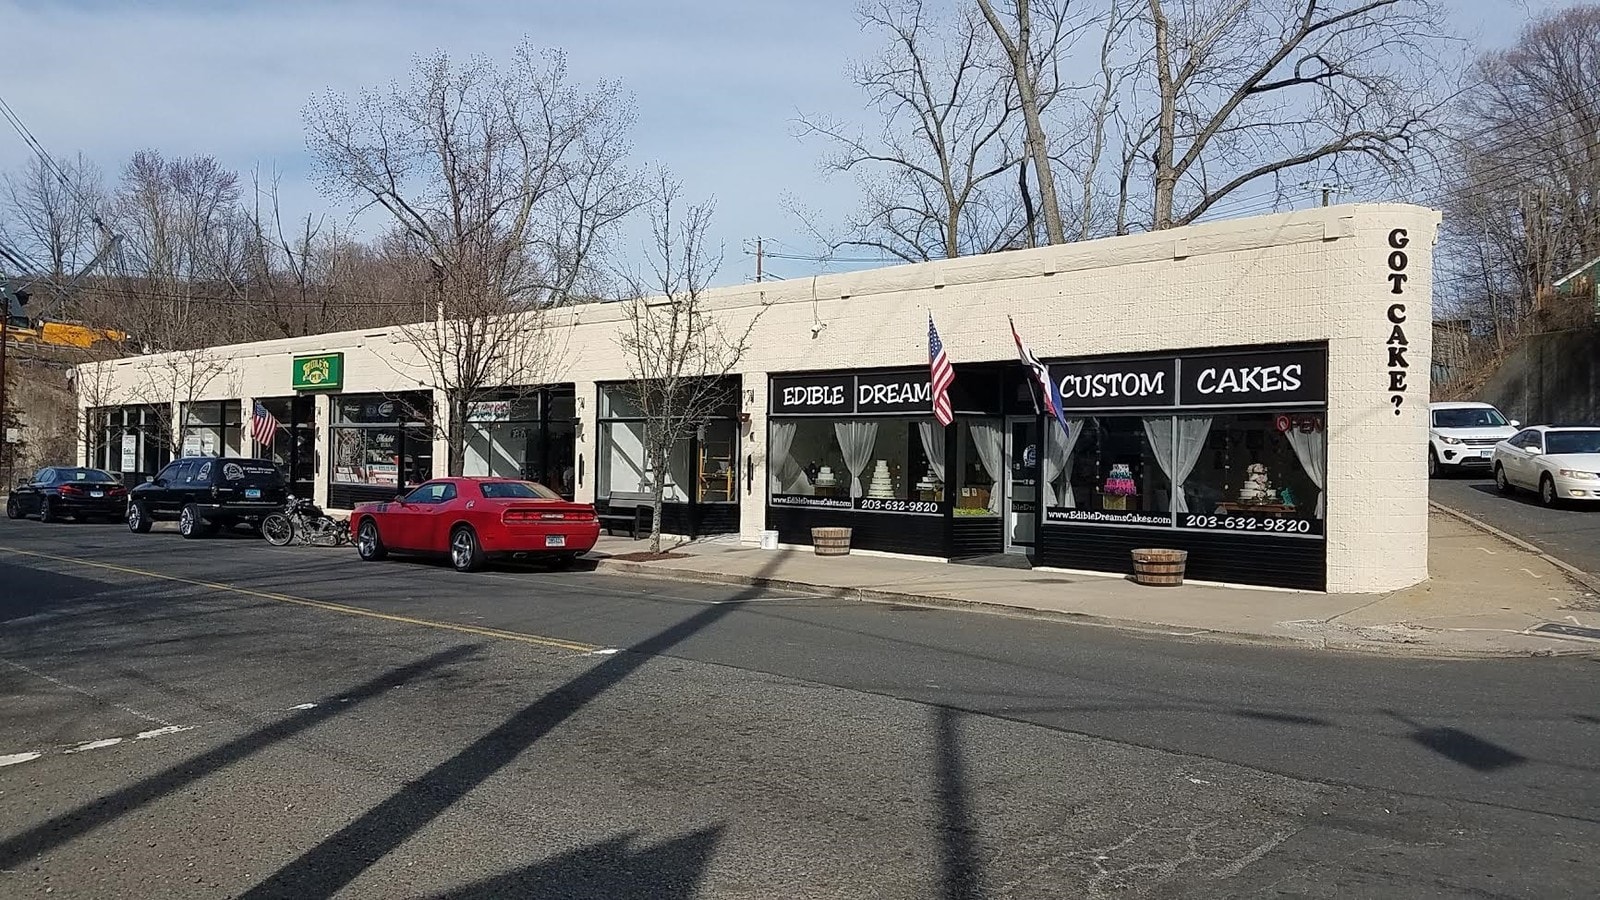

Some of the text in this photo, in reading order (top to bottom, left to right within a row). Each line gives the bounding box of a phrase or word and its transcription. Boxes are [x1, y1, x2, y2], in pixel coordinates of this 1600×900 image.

[1386, 228, 1410, 416] GOT CAKE?
[1059, 364, 1302, 398] CUSTOM CAKES
[783, 382, 932, 406] EDIBLE DREAM
[772, 496, 938, 512] www.EdibleDreamsCakes.com 203-632-9820
[1047, 510, 1310, 533] www.EdibleDreamsCakes.com 203-632-9820
